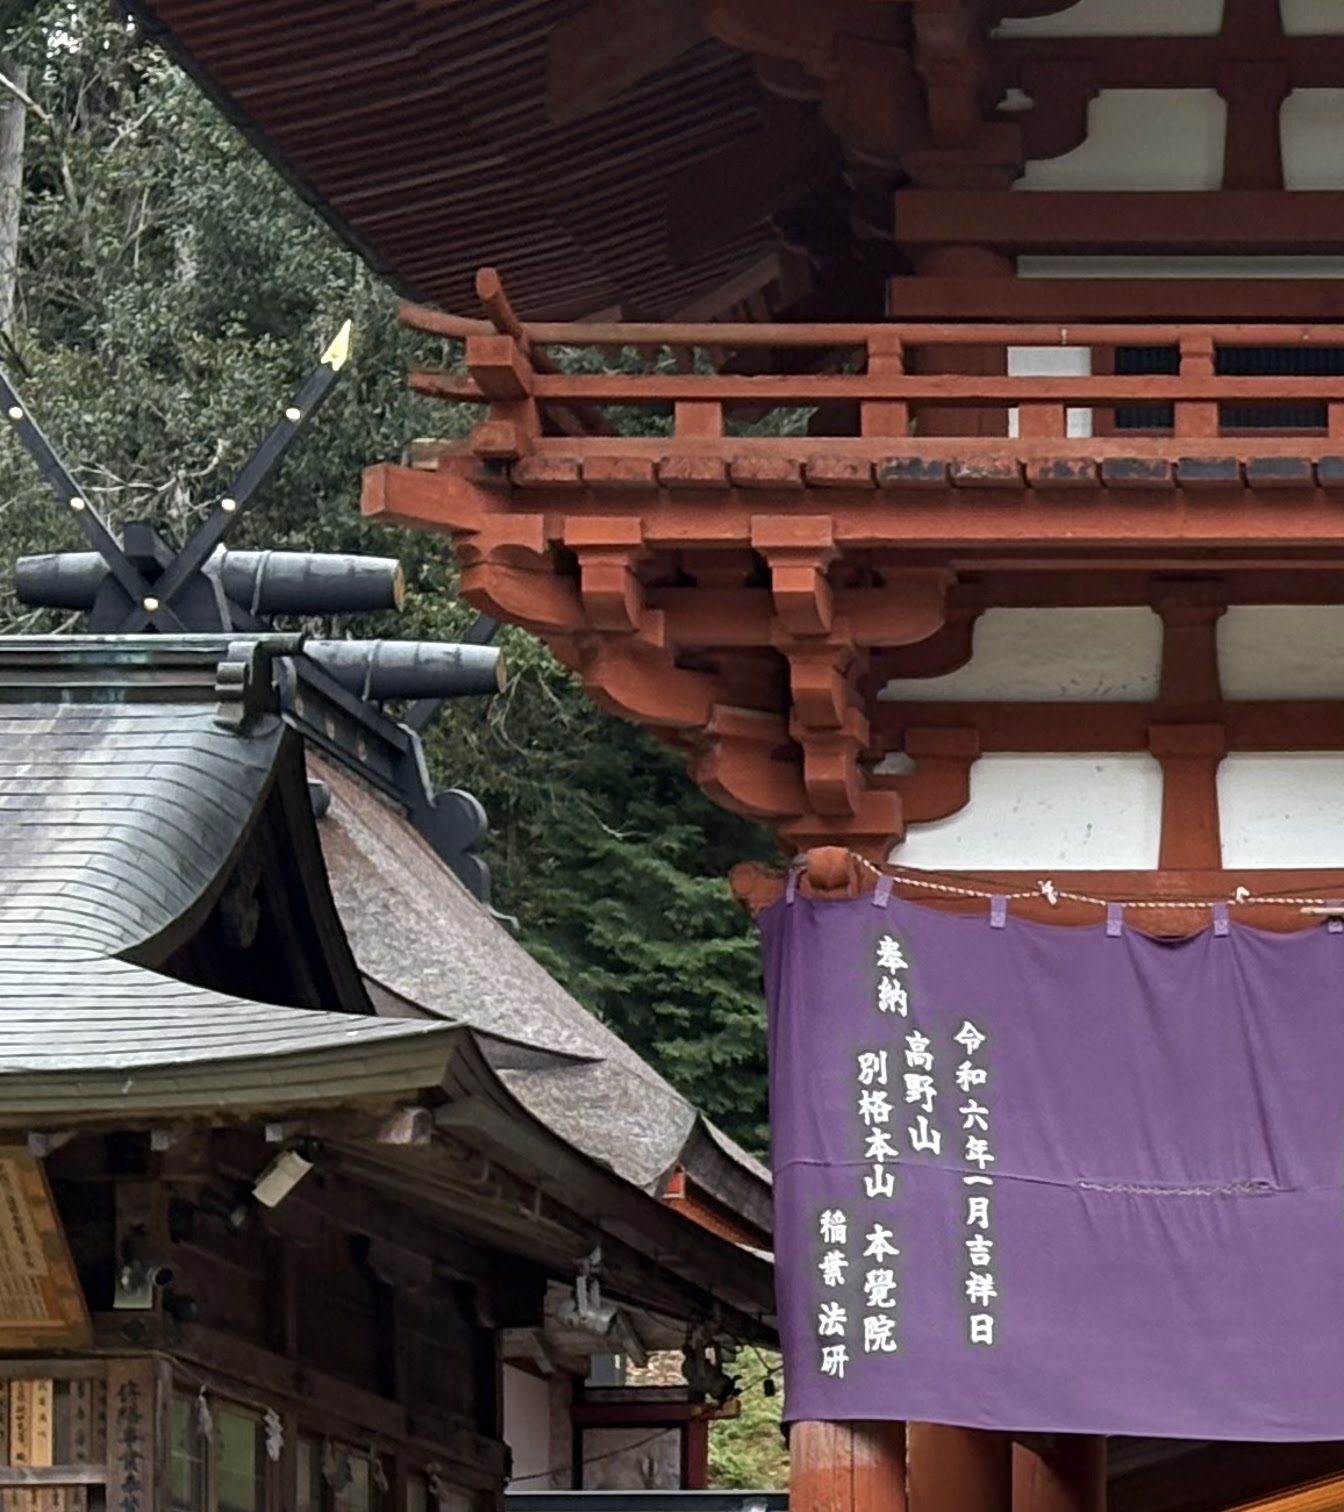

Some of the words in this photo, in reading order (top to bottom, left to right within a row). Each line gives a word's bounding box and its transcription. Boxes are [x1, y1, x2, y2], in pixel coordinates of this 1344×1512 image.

[876, 935, 909, 1017] 奉納
[857, 1050, 899, 1199] 別格本山
[904, 1030, 942, 1155] 高野山
[954, 1021, 998, 1346] 令和六年一月吉祥日
